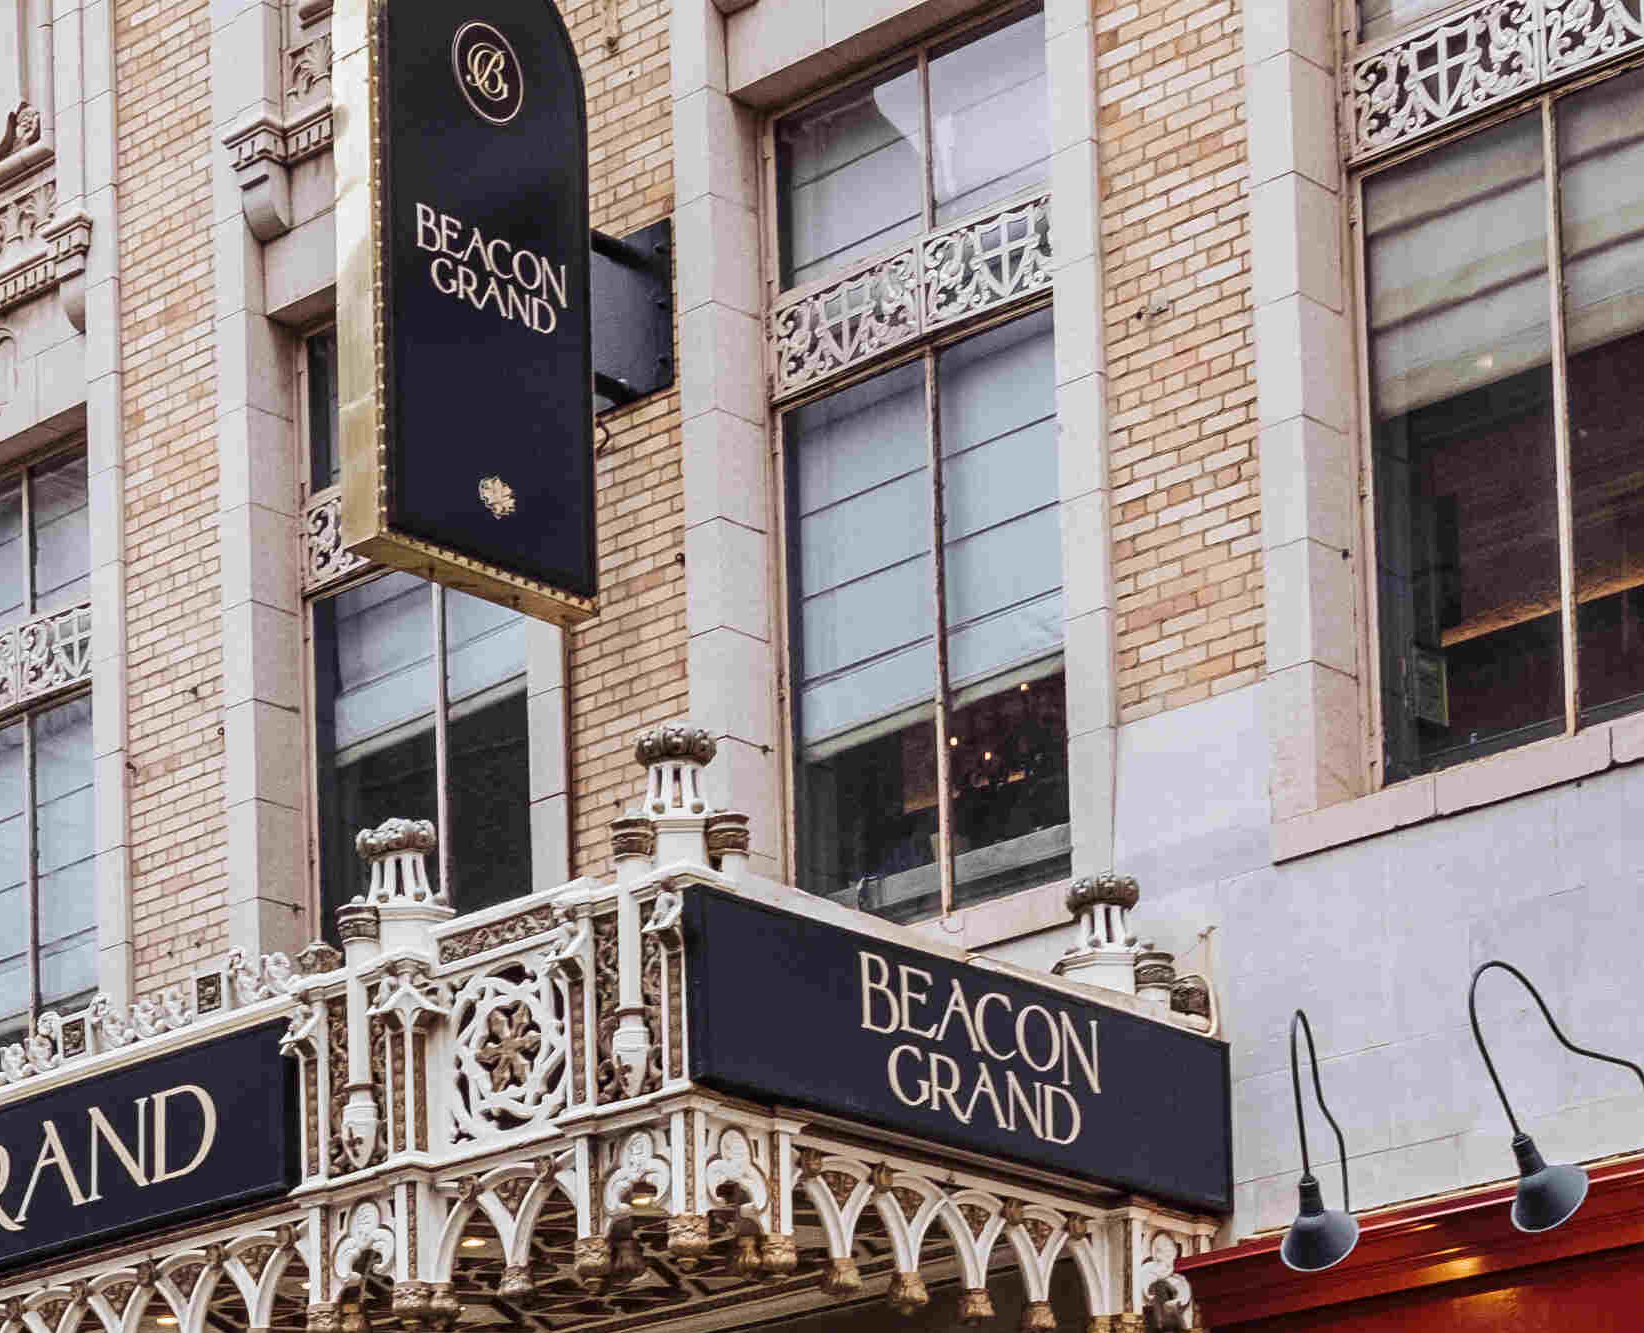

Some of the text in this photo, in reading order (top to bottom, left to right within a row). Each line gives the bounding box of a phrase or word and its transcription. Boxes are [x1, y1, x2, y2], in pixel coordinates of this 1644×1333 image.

[415, 202, 567, 309] BEACON
[431, 257, 557, 335] GRAND
[858, 951, 1101, 1094] BEACON
[887, 1044, 1081, 1145] GRAND
